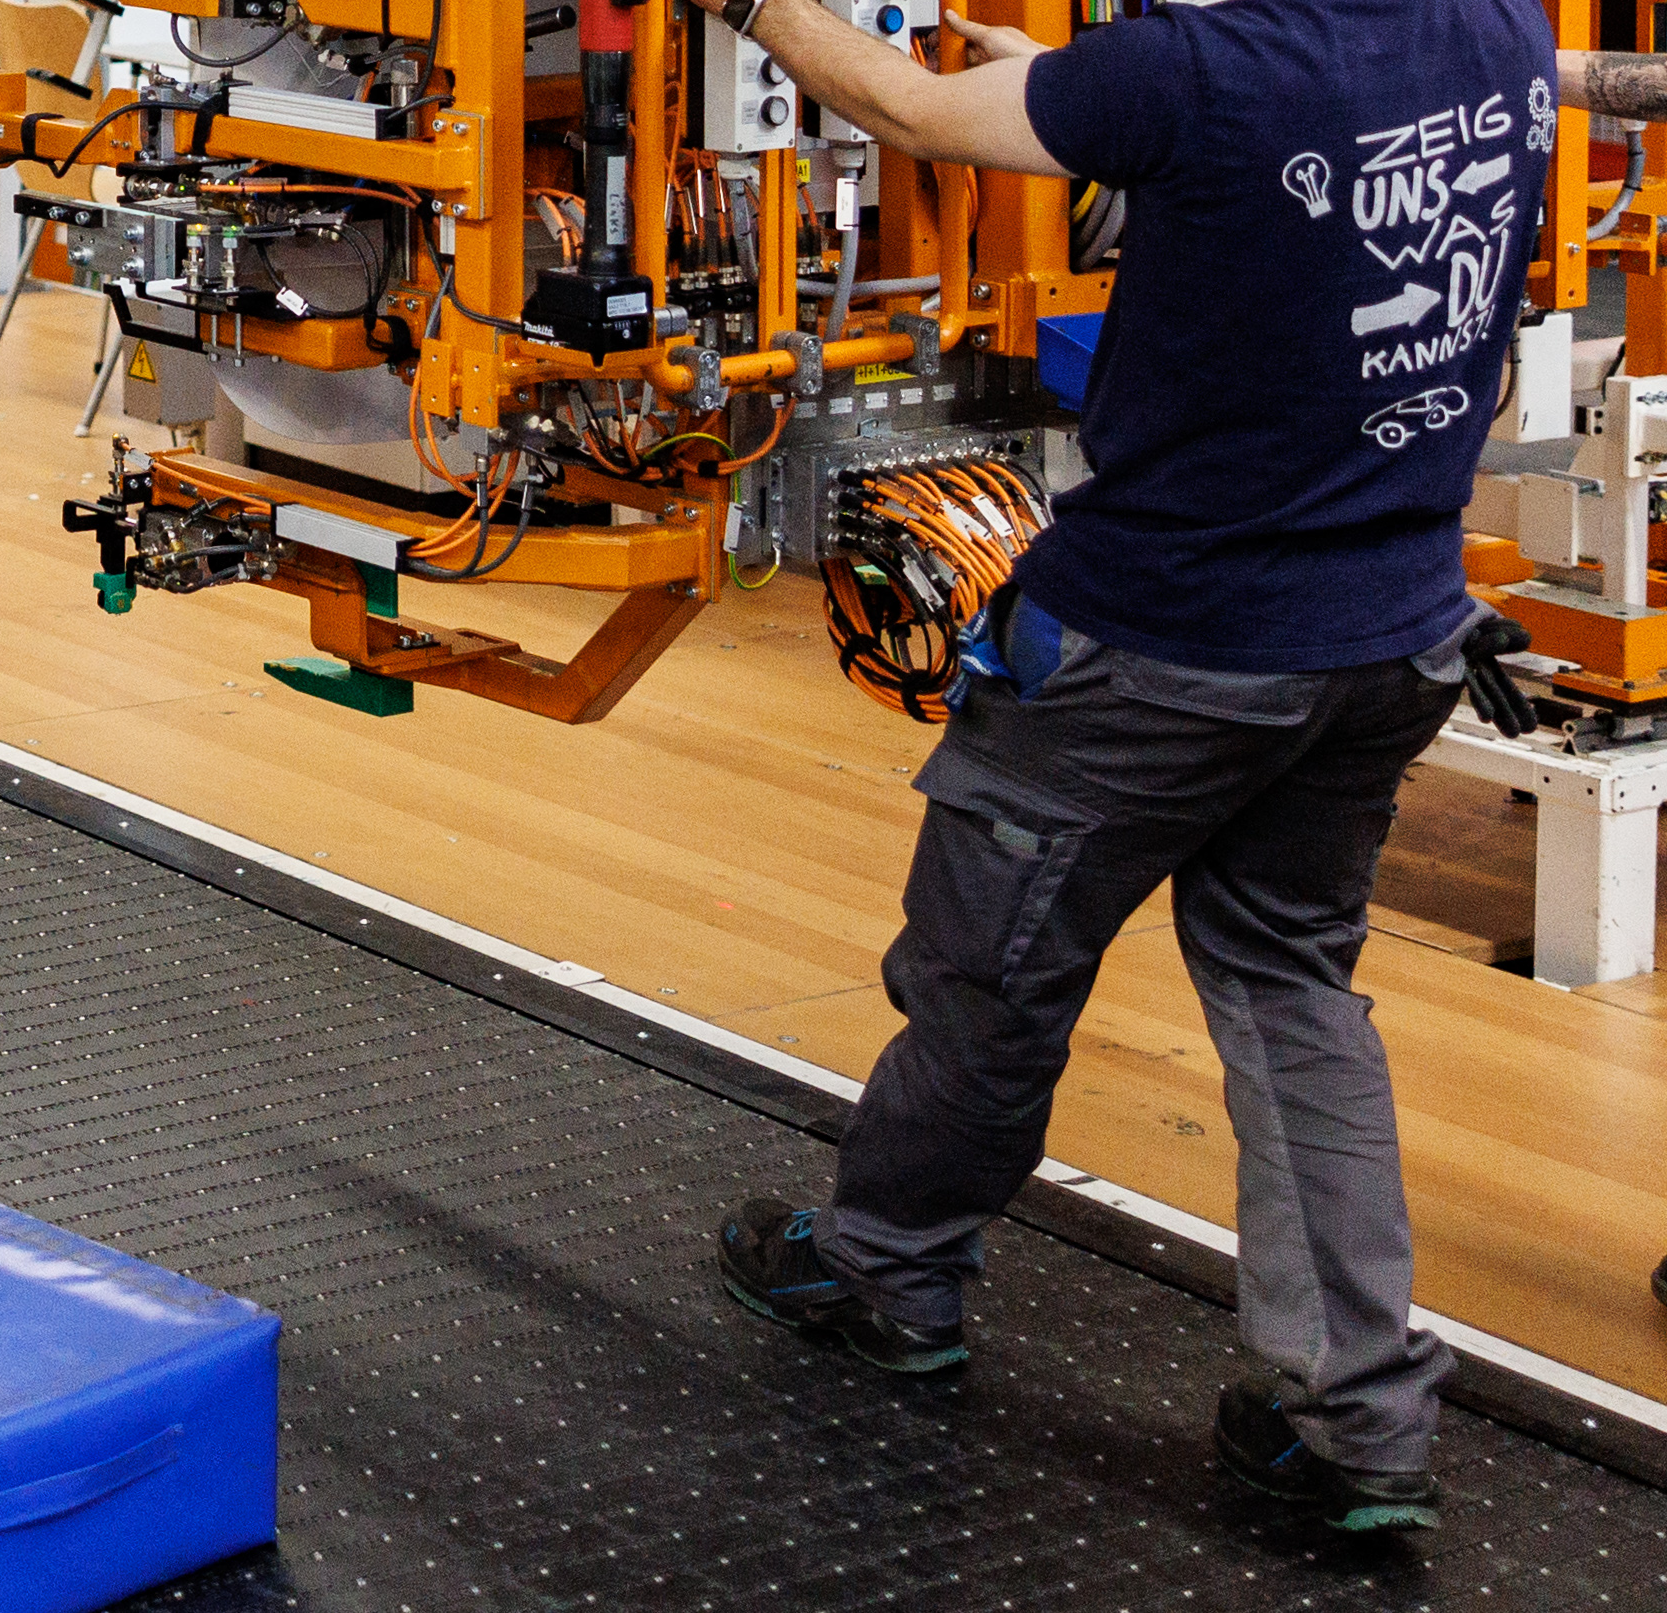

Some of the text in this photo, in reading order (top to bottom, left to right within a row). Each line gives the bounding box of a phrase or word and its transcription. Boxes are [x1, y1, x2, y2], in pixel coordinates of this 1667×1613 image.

[1355, 93, 1511, 172] ZEIG
[1352, 159, 1449, 230] UNS
[1364, 189, 1515, 270] WAS
[1447, 228, 1509, 328] DU
[1361, 304, 1496, 378] KANNST!
